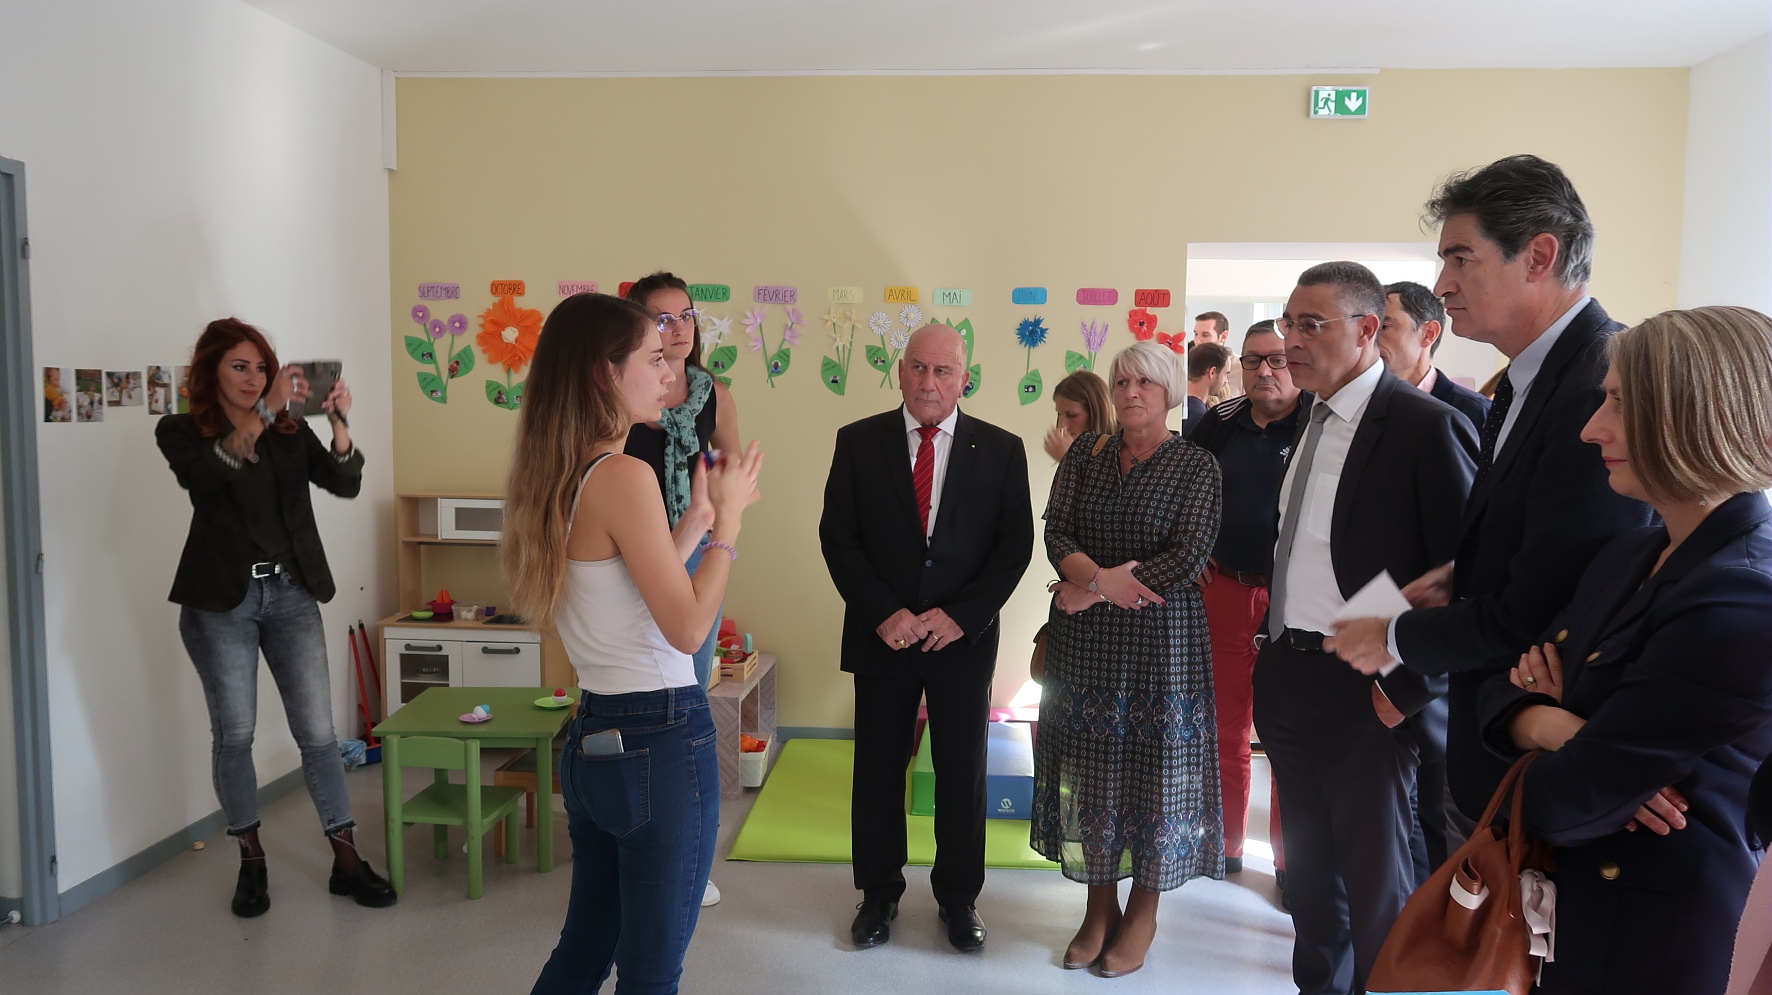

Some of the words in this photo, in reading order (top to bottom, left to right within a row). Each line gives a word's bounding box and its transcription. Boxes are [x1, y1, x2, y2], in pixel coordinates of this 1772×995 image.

[491, 282, 523, 295] OCTOBRE
[832, 288, 855, 301] MARS
[1138, 289, 1168, 306] AOÛT
